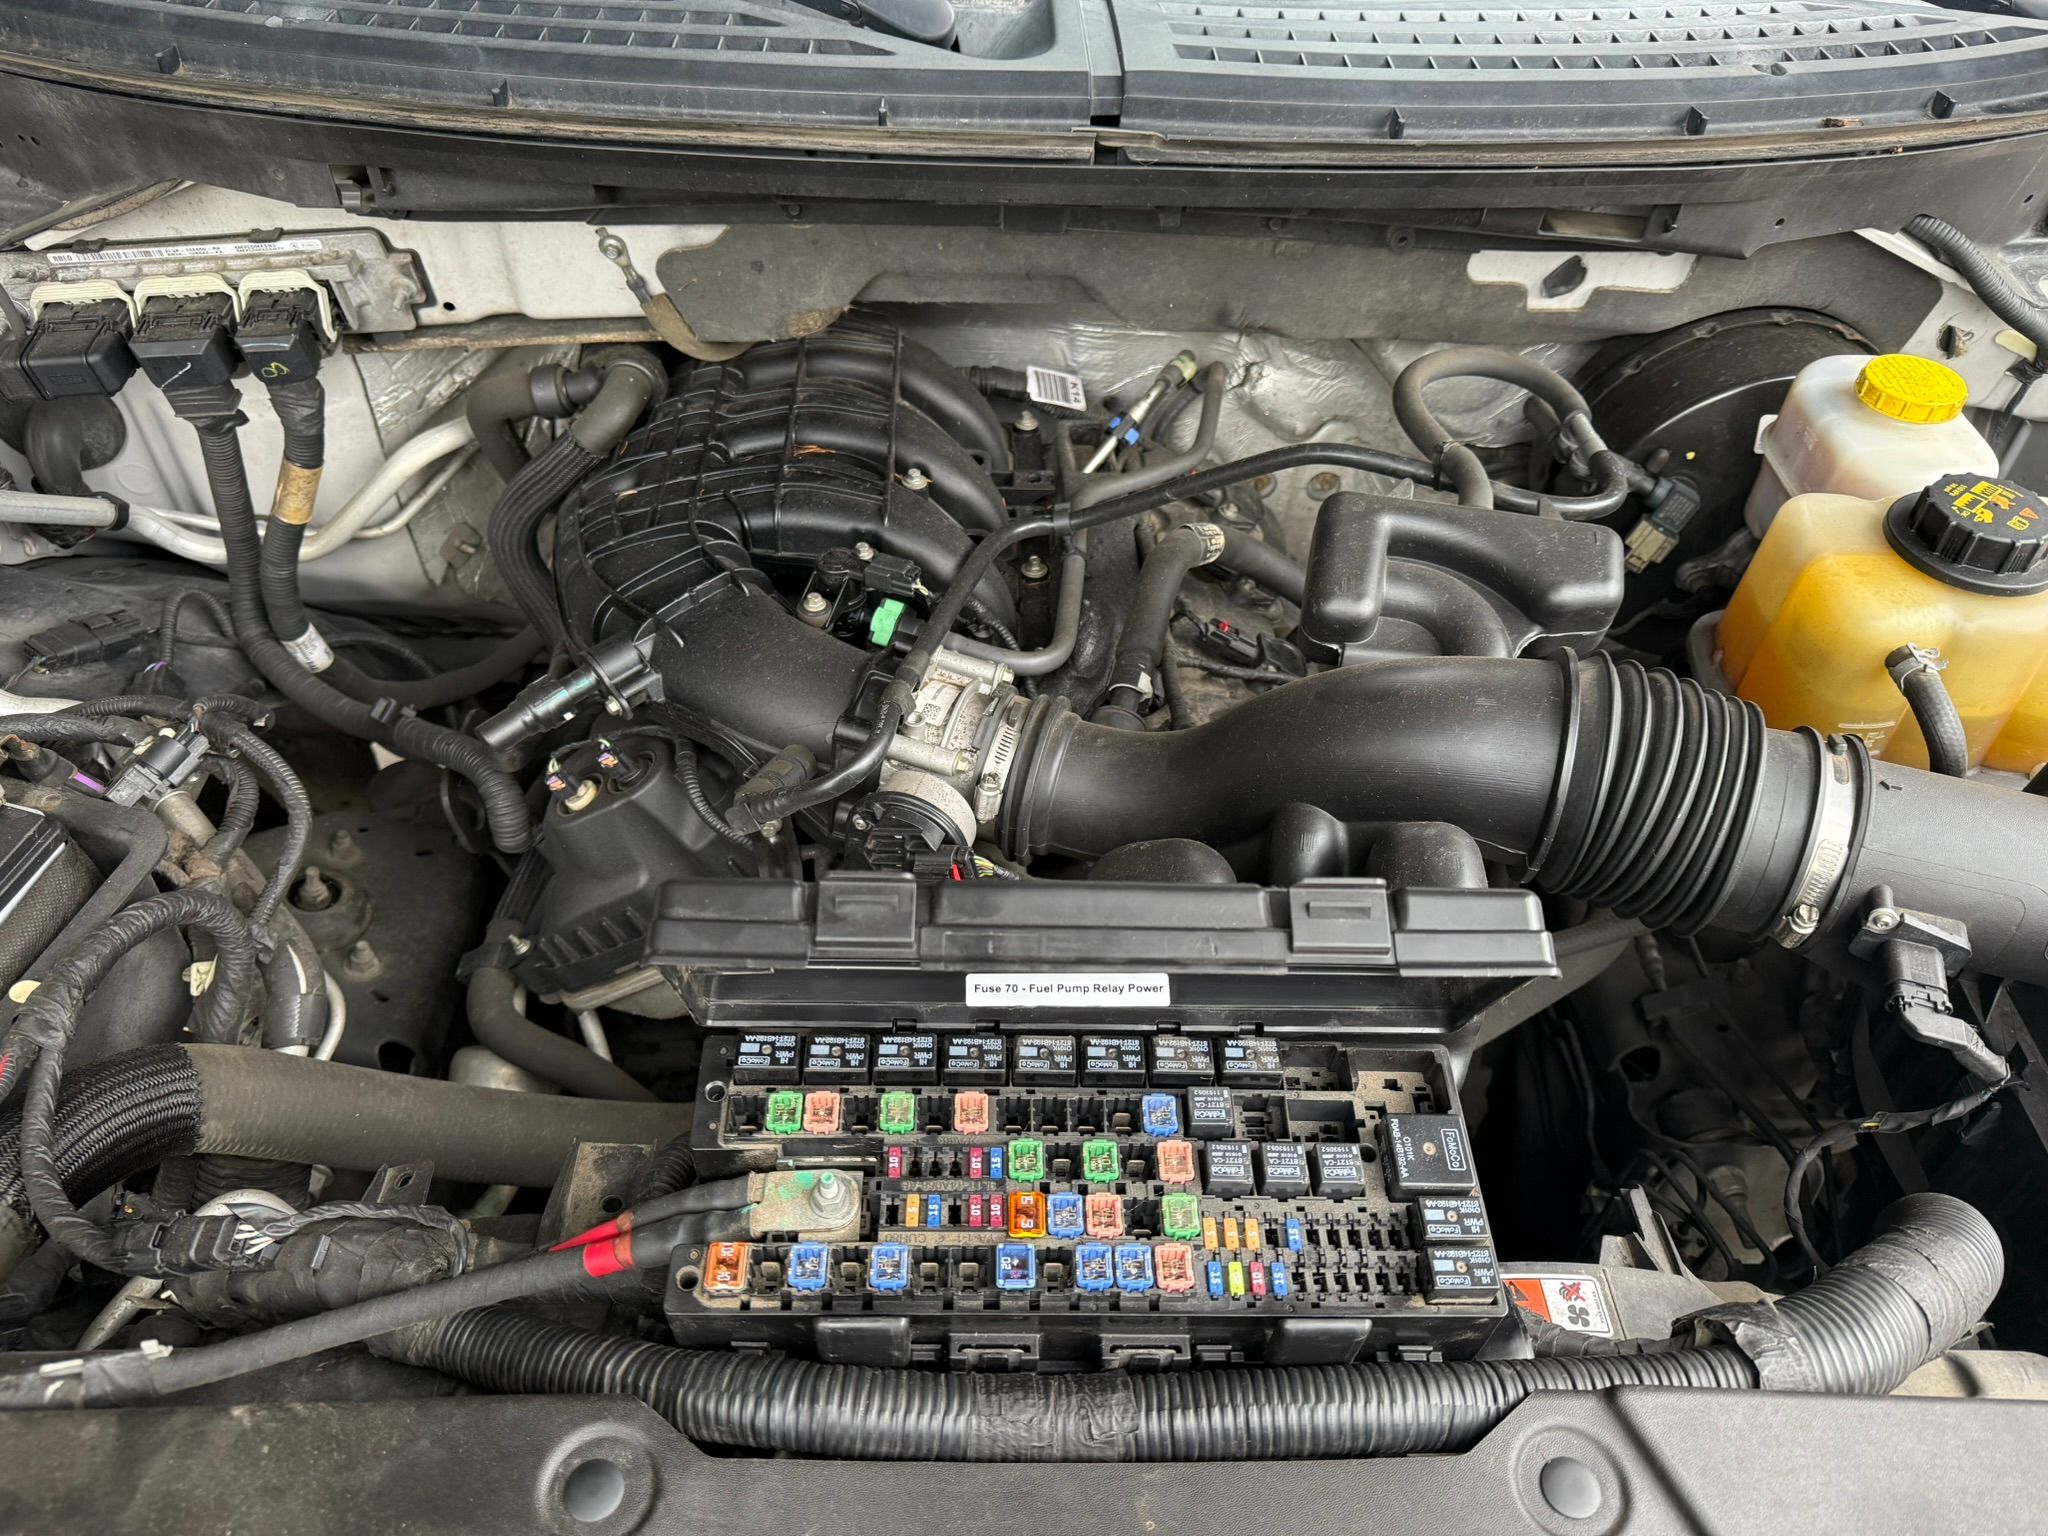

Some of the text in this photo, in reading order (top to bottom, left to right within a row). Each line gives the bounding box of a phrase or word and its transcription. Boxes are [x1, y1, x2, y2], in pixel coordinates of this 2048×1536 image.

[974, 984, 1002, 993] Fuse
[1005, 984, 1019, 993] 70
[1029, 983, 1053, 993] Fuel
[1057, 984, 1090, 995] Pump
[1093, 983, 1124, 995] Relay
[1128, 984, 1164, 993] Power
[914, 1051, 932, 1059] PWR
[811, 1059, 838, 1067] FoMoCo
[1089, 1061, 1116, 1069] FoMoCo
[1159, 1061, 1186, 1069] FoMoCo
[1445, 1131, 1460, 1168] FoMoCo
[1213, 1166, 1243, 1174] FoMoCo
[1268, 1167, 1299, 1175] FoMoCo
[1324, 1168, 1355, 1176] FoMoCo
[1001, 1257, 1011, 1270] 20
